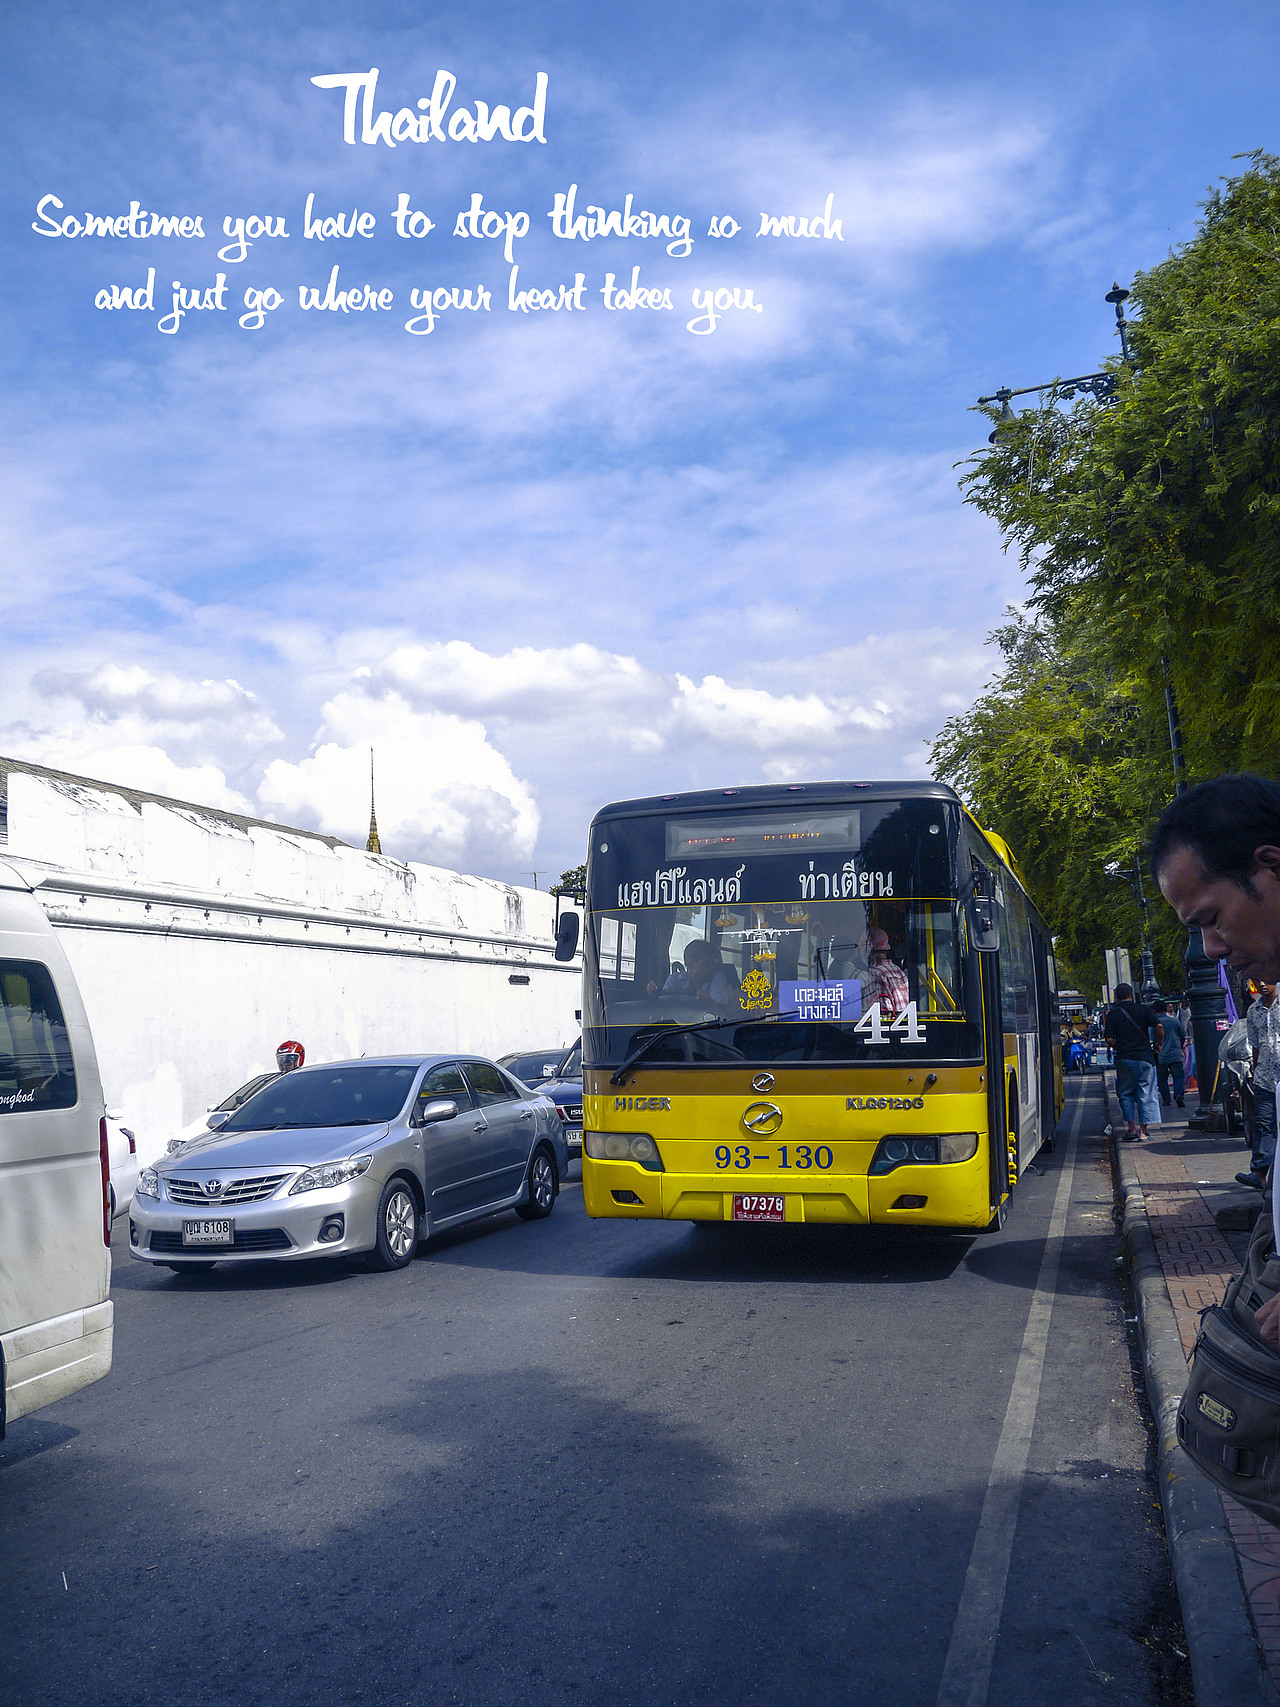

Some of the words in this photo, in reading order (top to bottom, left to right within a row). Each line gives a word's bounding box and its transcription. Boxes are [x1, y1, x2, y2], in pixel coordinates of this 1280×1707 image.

[617, 863, 747, 907] แฮปปี้แลนด์
[798, 858, 894, 899] ท่าเตียน
[797, 1002, 841, 1020] บางกะปิ
[853, 1000, 927, 1045] 44
[614, 1096, 671, 1111] HIGER
[845, 1096, 924, 1111] KLQ6120G
[714, 1145, 834, 1170] 93-130
[742, 1196, 783, 1212] 07378
[203, 1221, 229, 1234] 6108
